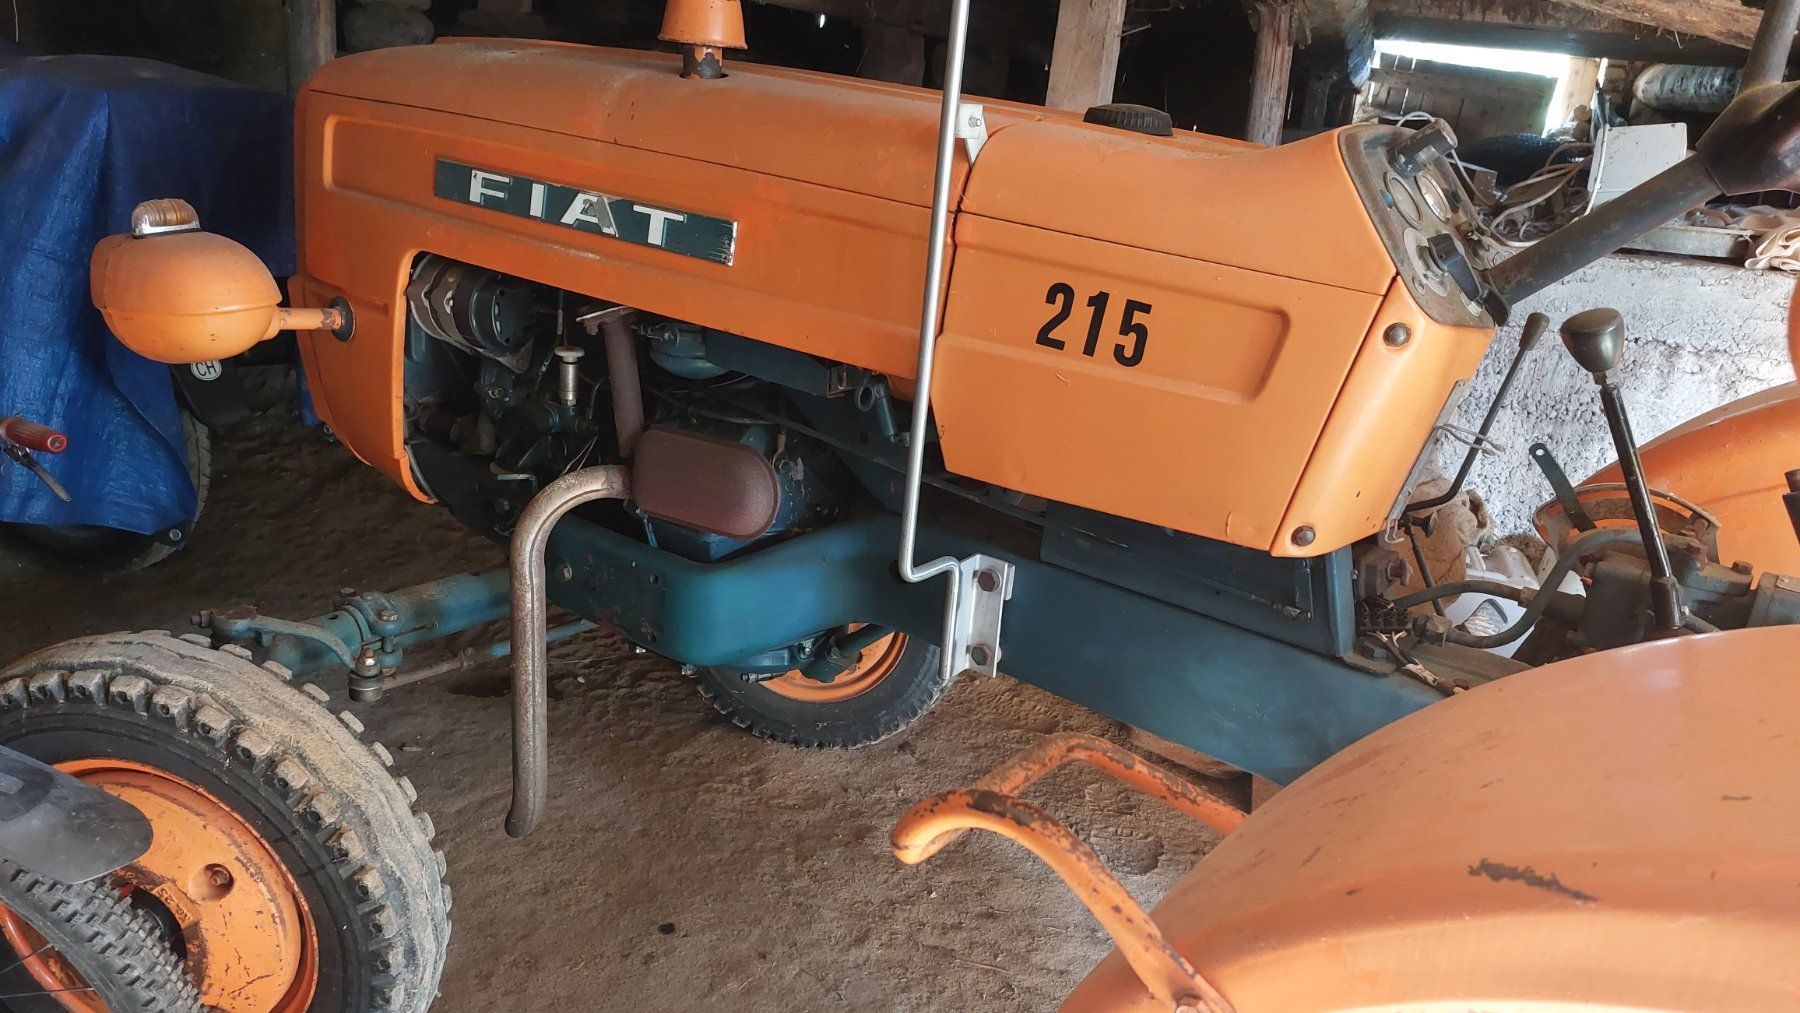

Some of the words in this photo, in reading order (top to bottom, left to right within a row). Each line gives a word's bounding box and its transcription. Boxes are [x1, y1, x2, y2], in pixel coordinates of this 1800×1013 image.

[469, 169, 687, 246] FIAT
[1035, 282, 1152, 368] 215
[195, 360, 217, 376] CH
